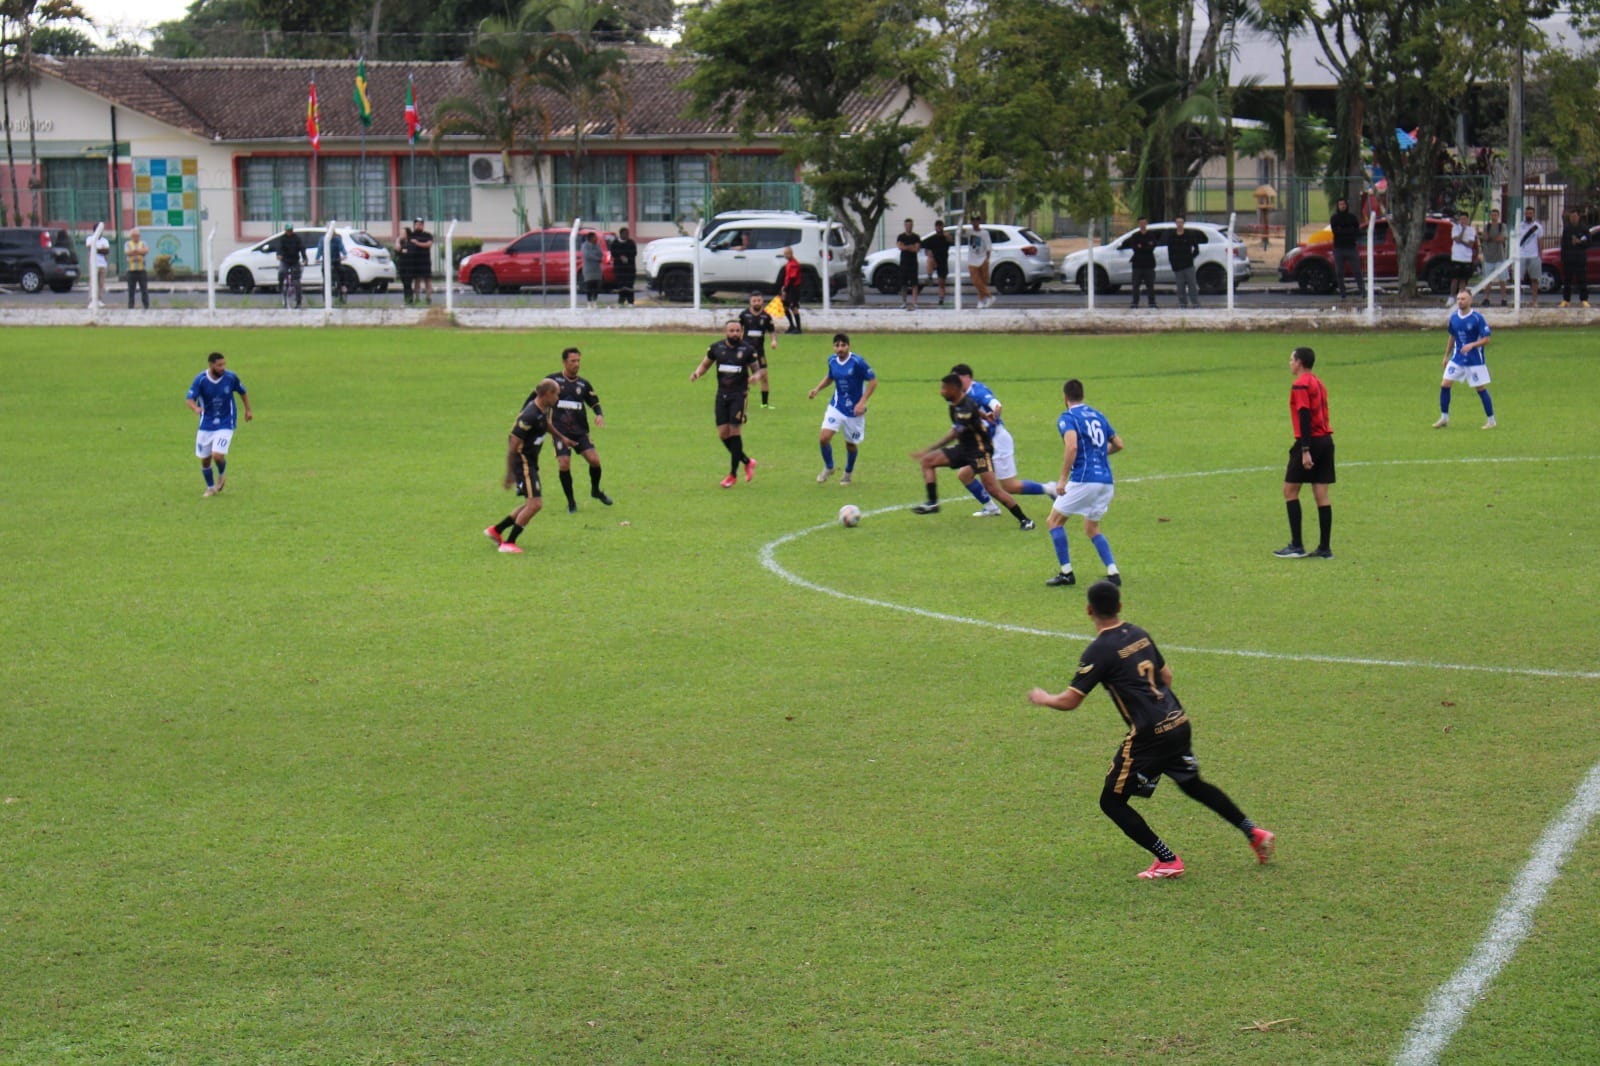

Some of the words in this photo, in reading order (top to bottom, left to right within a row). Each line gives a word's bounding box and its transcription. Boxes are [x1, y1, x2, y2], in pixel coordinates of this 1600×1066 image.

[217, 437, 228, 448] 10
[1085, 419, 1105, 447] 16
[1137, 660, 1164, 700] 7
